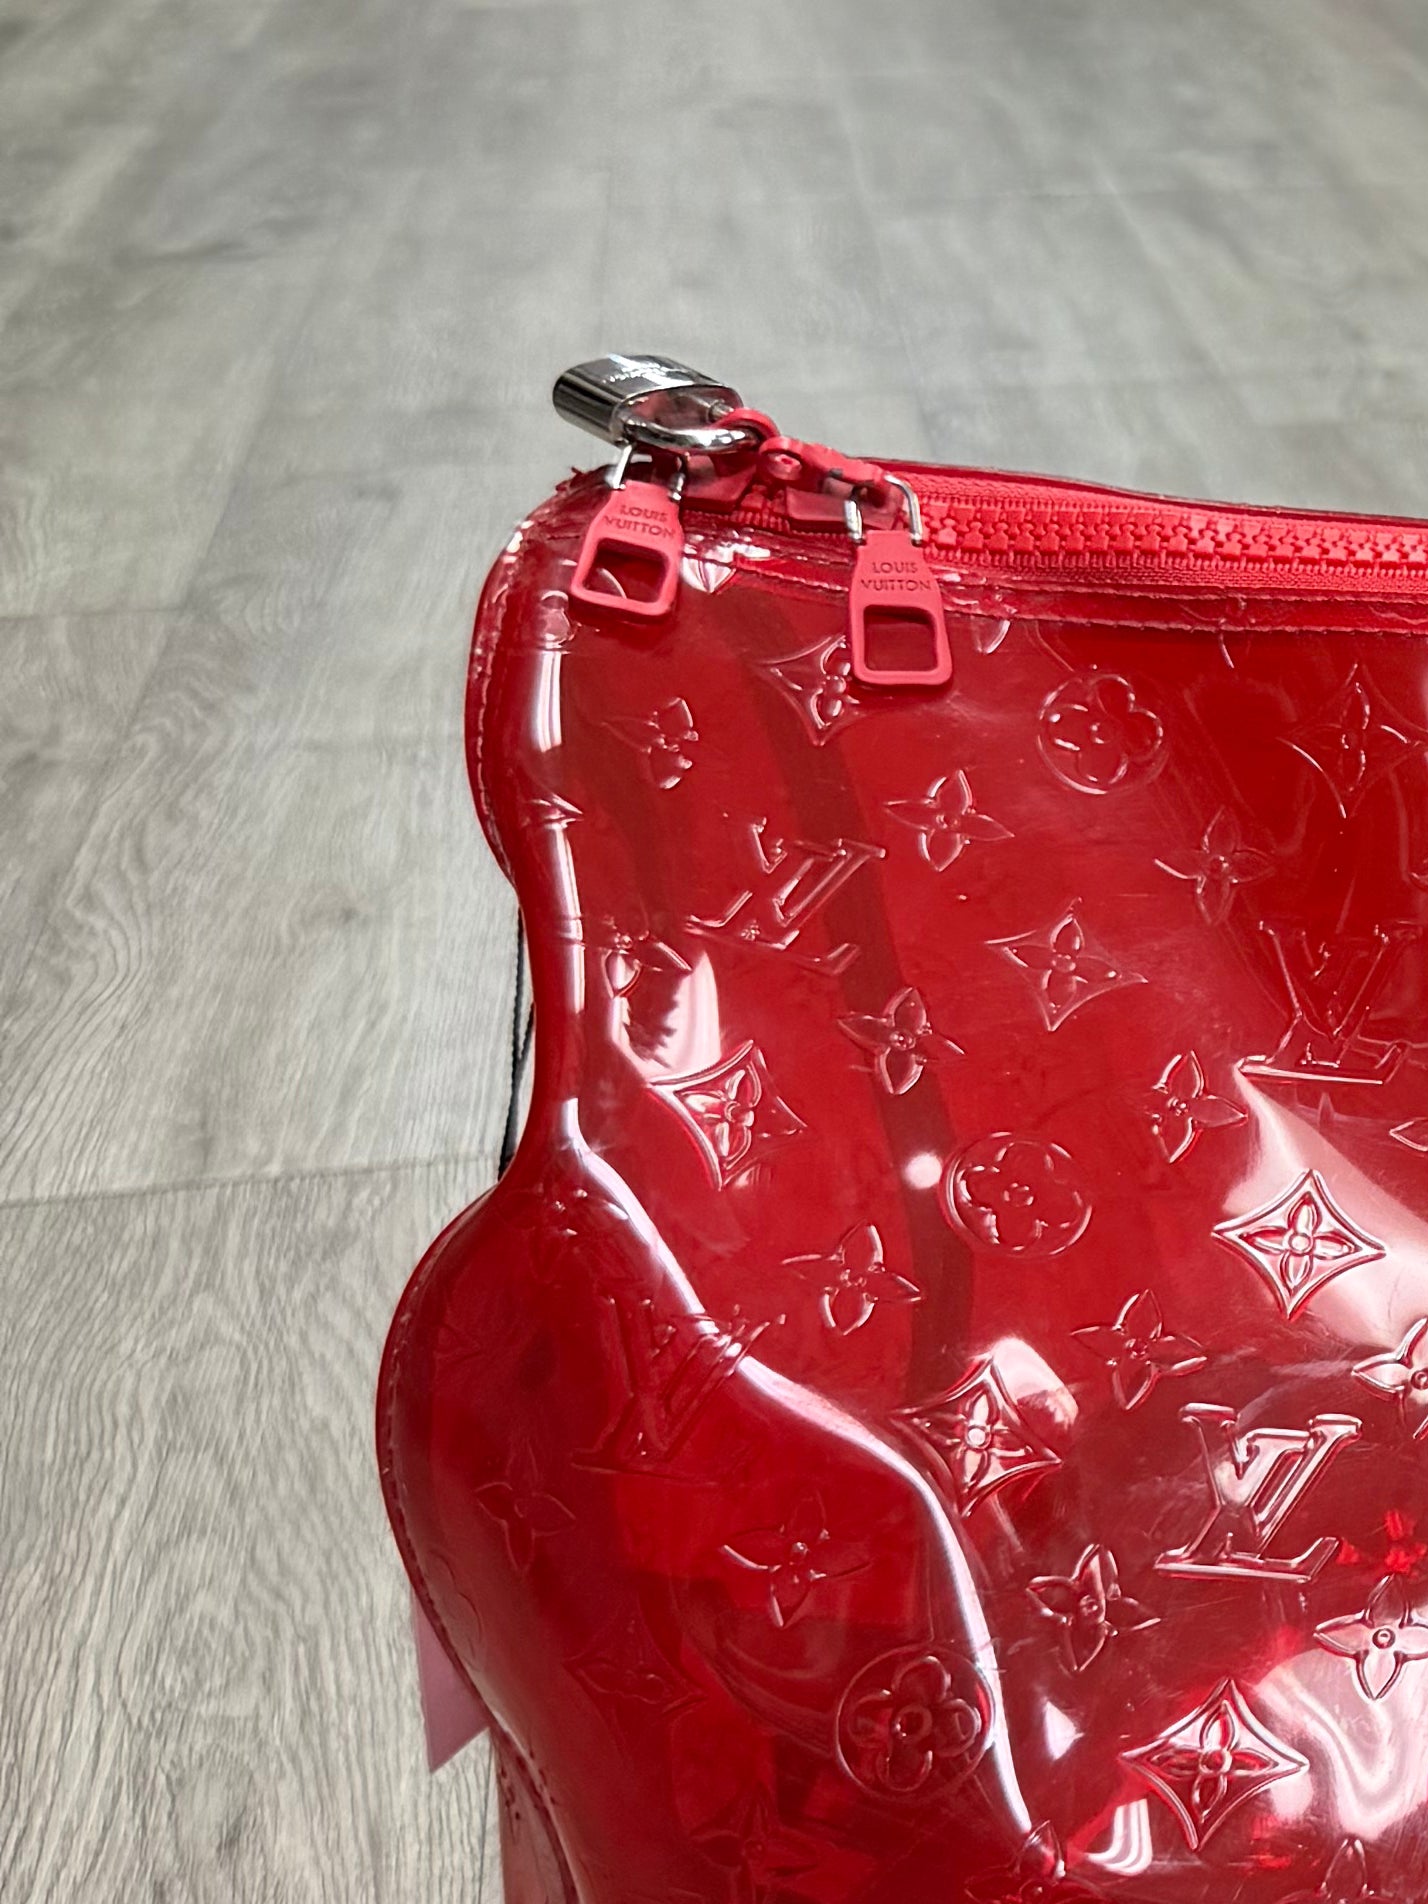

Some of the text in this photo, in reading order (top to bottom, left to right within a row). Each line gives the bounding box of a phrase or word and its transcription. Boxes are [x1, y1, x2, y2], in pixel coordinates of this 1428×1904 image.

[618, 503, 669, 524] LOUIS
[602, 514, 678, 539] VUITTON
[871, 561, 919, 574] LOUIS
[859, 579, 932, 592] VUITTON
[1154, 1402, 1364, 1583] LV
